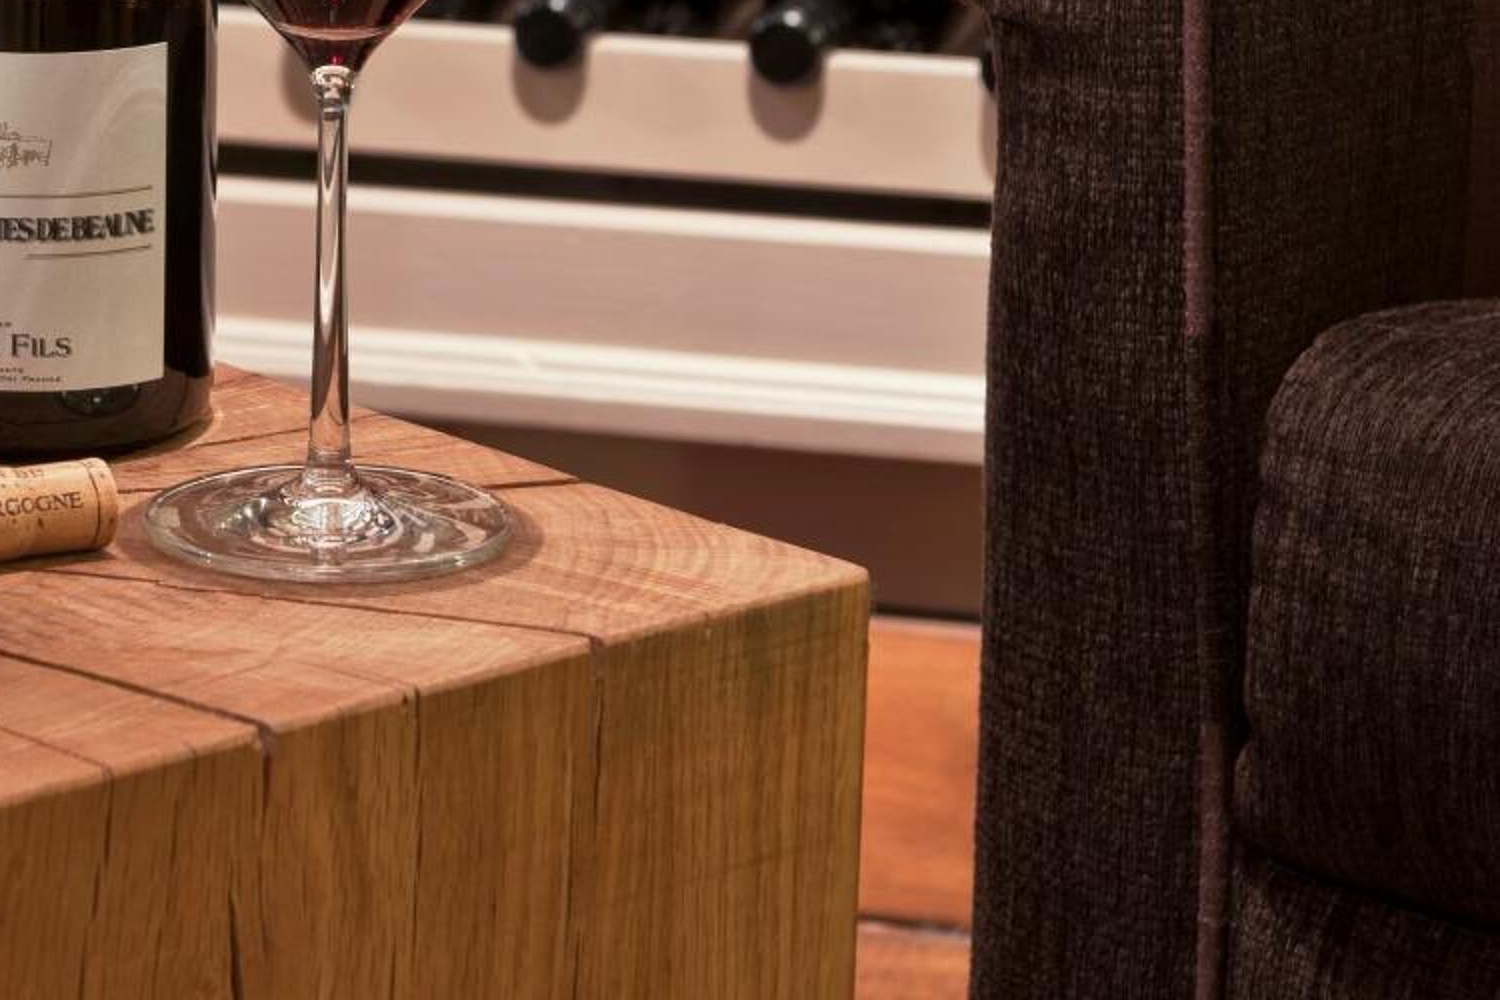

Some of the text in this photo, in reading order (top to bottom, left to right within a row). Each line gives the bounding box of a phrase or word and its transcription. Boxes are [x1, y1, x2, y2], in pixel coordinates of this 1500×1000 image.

[35, 216, 71, 242] DE
[71, 207, 155, 241] BEAUNE
[11, 333, 73, 359] FILS
